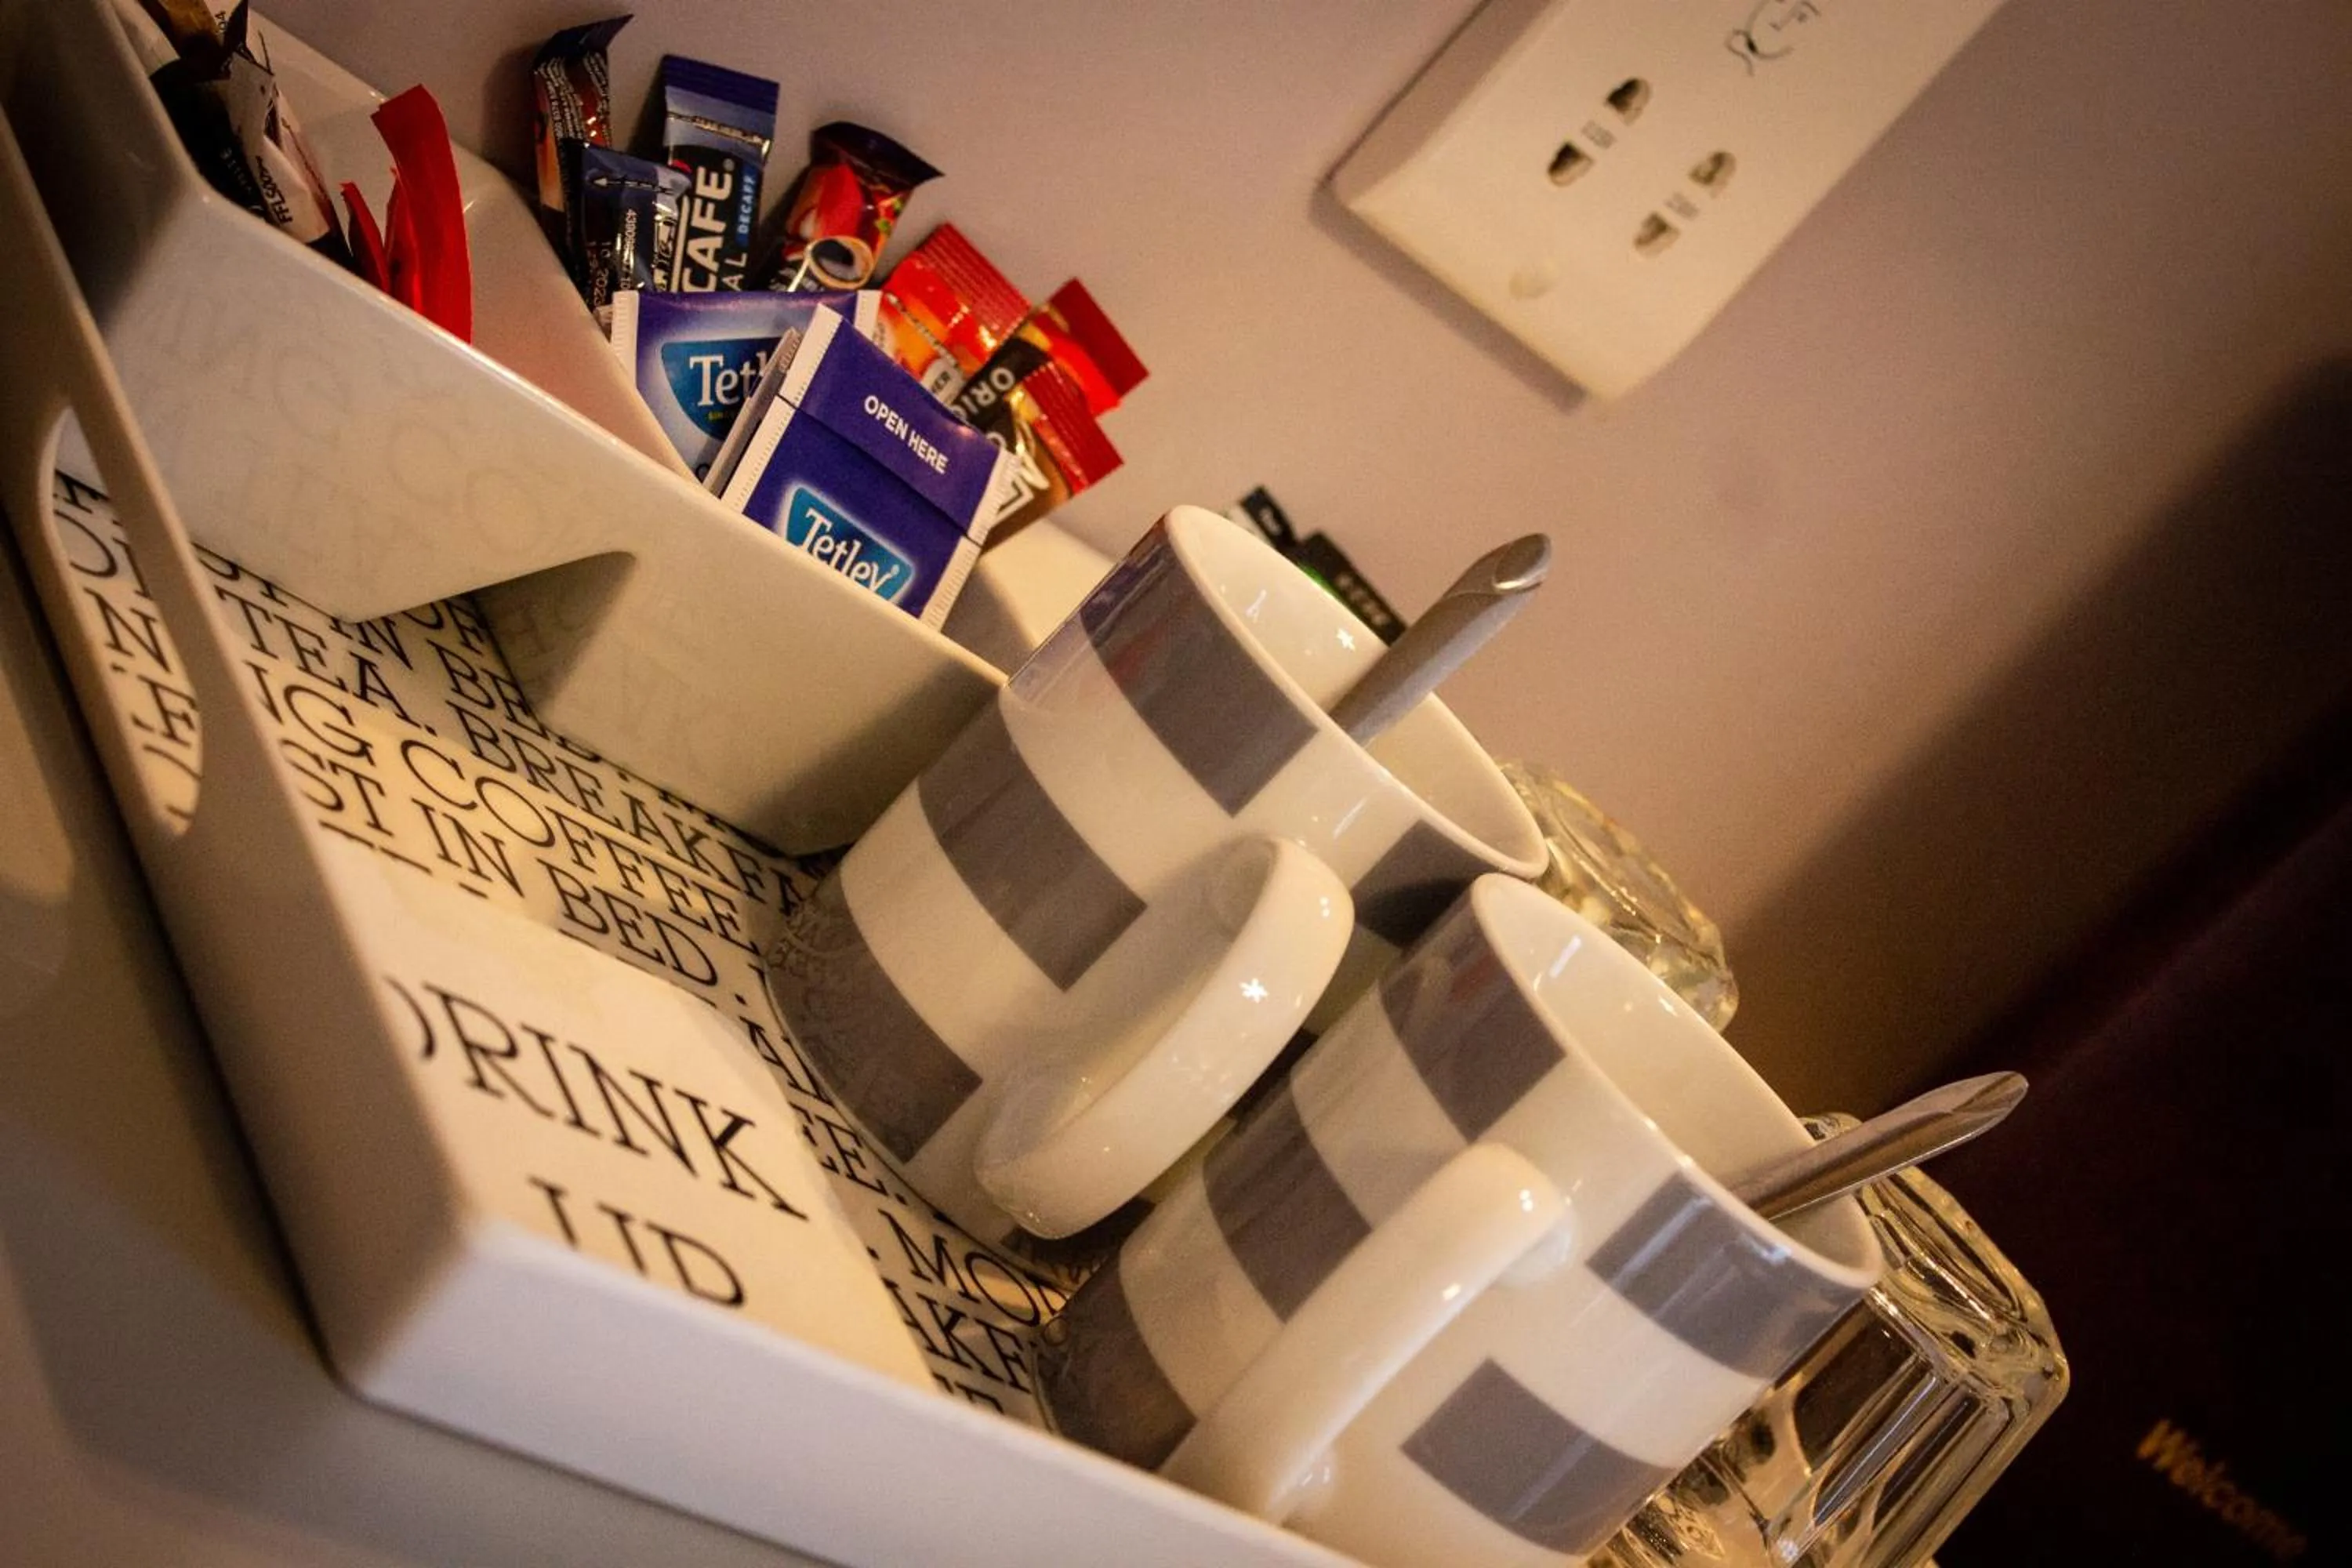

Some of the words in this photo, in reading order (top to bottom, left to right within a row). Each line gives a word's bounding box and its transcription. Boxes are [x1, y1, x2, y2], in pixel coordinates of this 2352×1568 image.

[863, 395, 908, 440] OPEN
[908, 430, 950, 474] HERE
[213, 583, 438, 738] TEA.
[400, 739, 763, 957] COFFEE
[410, 797, 525, 898] IN
[536, 858, 747, 1006] BED.
